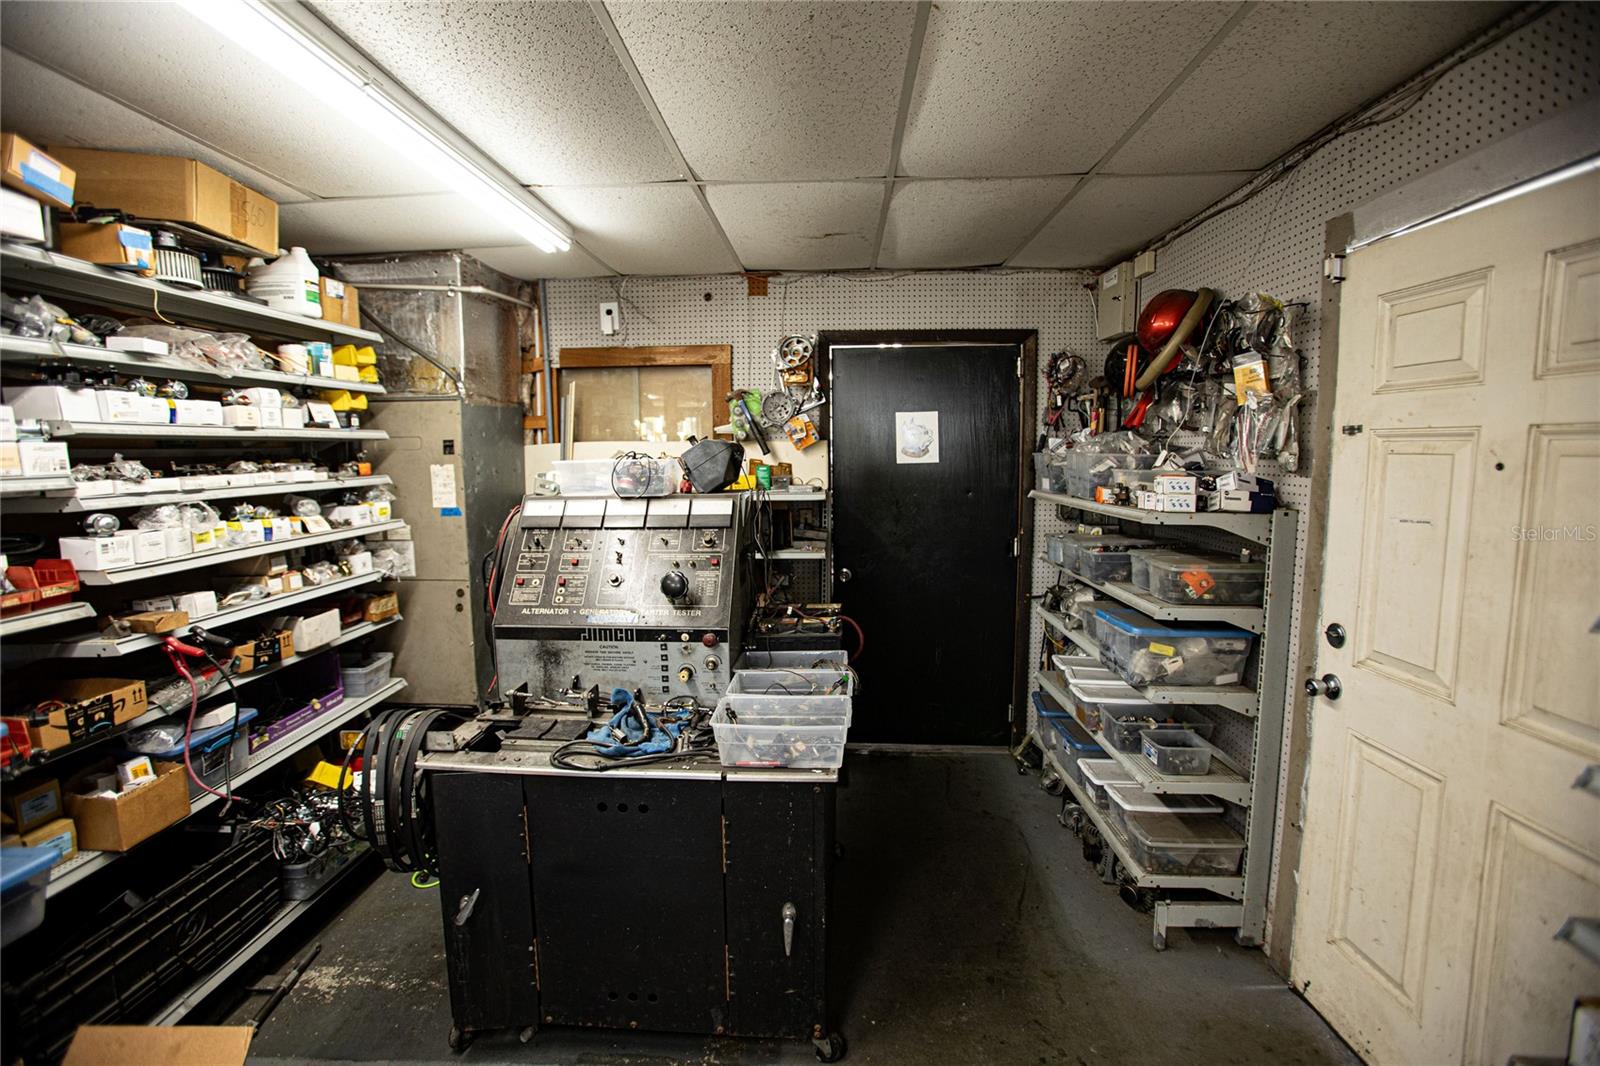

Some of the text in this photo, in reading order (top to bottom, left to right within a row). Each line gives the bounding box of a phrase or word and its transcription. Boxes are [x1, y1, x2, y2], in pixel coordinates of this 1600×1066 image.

[521, 607, 570, 616] ALTERNATOR
[638, 608, 670, 617] ARTER
[673, 609, 702, 617] TESTER
